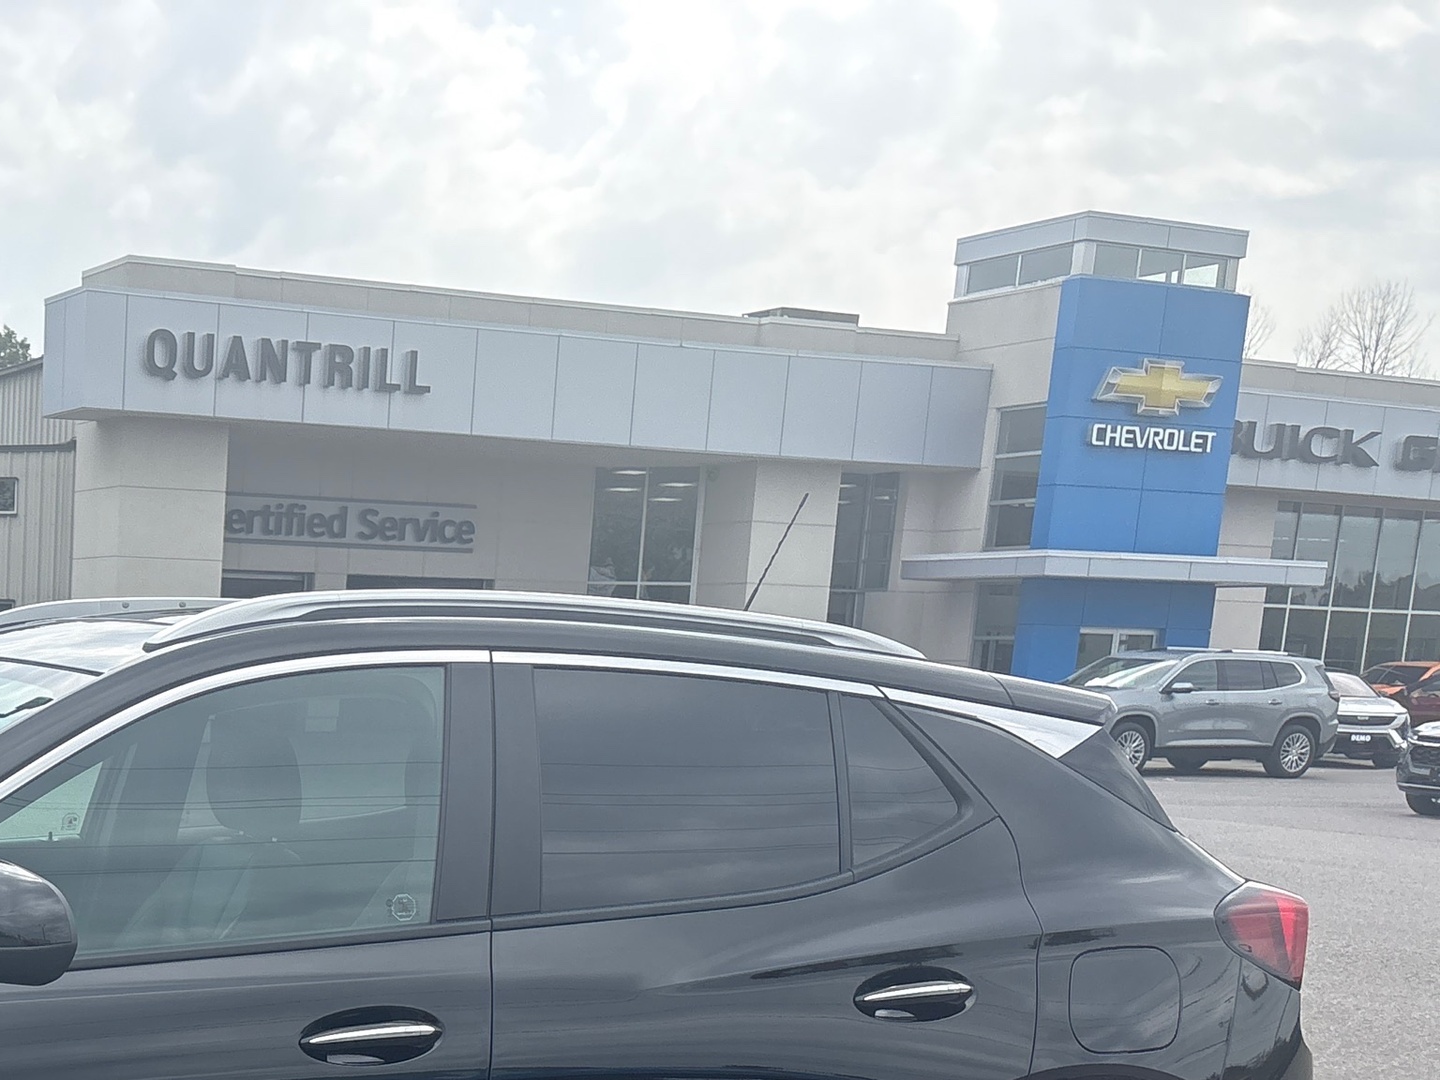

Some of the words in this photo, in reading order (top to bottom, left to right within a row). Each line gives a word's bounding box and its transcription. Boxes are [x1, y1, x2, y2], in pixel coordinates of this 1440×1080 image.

[144, 328, 431, 395] QUANTRILL
[1090, 423, 1217, 453] CHEVROLET
[224, 502, 348, 539] ertified
[357, 508, 475, 545] Service
[1350, 734, 1371, 742] DEMO
